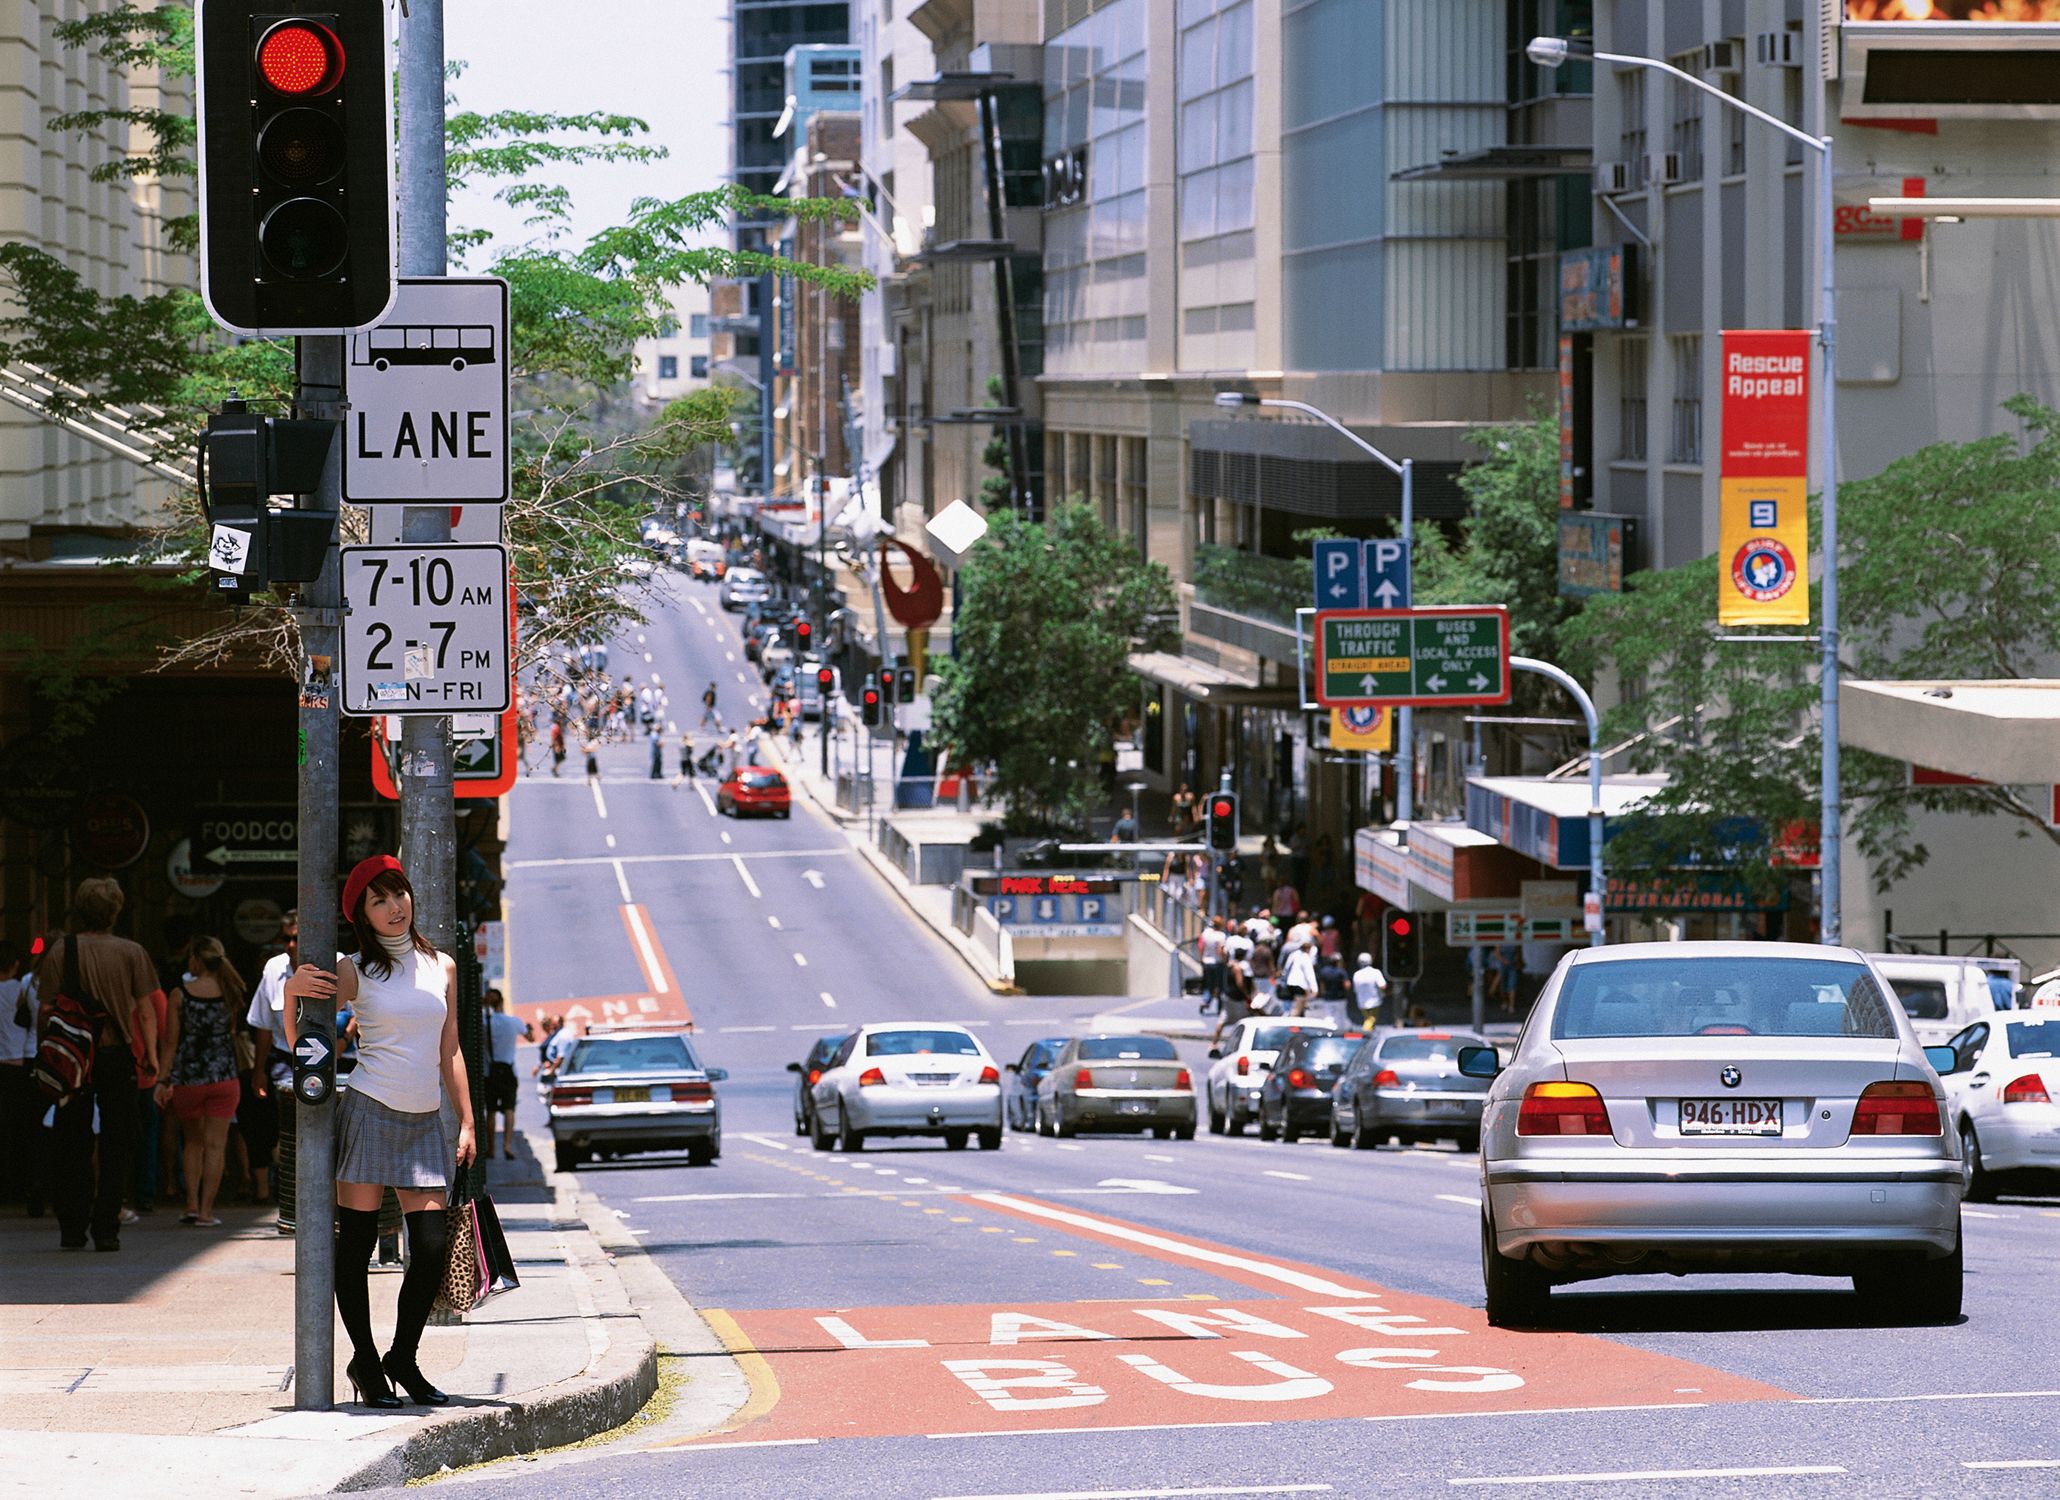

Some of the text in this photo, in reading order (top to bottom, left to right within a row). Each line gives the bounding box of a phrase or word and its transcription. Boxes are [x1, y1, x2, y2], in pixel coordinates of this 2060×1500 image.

[1729, 353, 1803, 373] Rescue
[1729, 376, 1803, 398] Appeal
[358, 411, 492, 458] LANE
[1752, 503, 1775, 525] 9
[1327, 551, 1350, 579] P
[1376, 543, 1401, 574] P
[362, 557, 492, 607] 7-10 AM
[1336, 622, 1401, 638] THROUGH
[1436, 620, 1477, 633] BUSES
[366, 621, 491, 670] 2-7 PM
[1340, 639, 1397, 655] TRAFFIC
[1443, 633, 1470, 646] AND
[1416, 645, 1499, 660] LOCAL ACCESS
[1441, 660, 1473, 672] ONLY
[367, 681, 482, 701] MN-FRI
[201, 820, 298, 841] FOODCO
[994, 900, 1100, 920] P P
[812, 1305, 1470, 1348] LANE
[940, 1349, 1525, 1411] BUS
